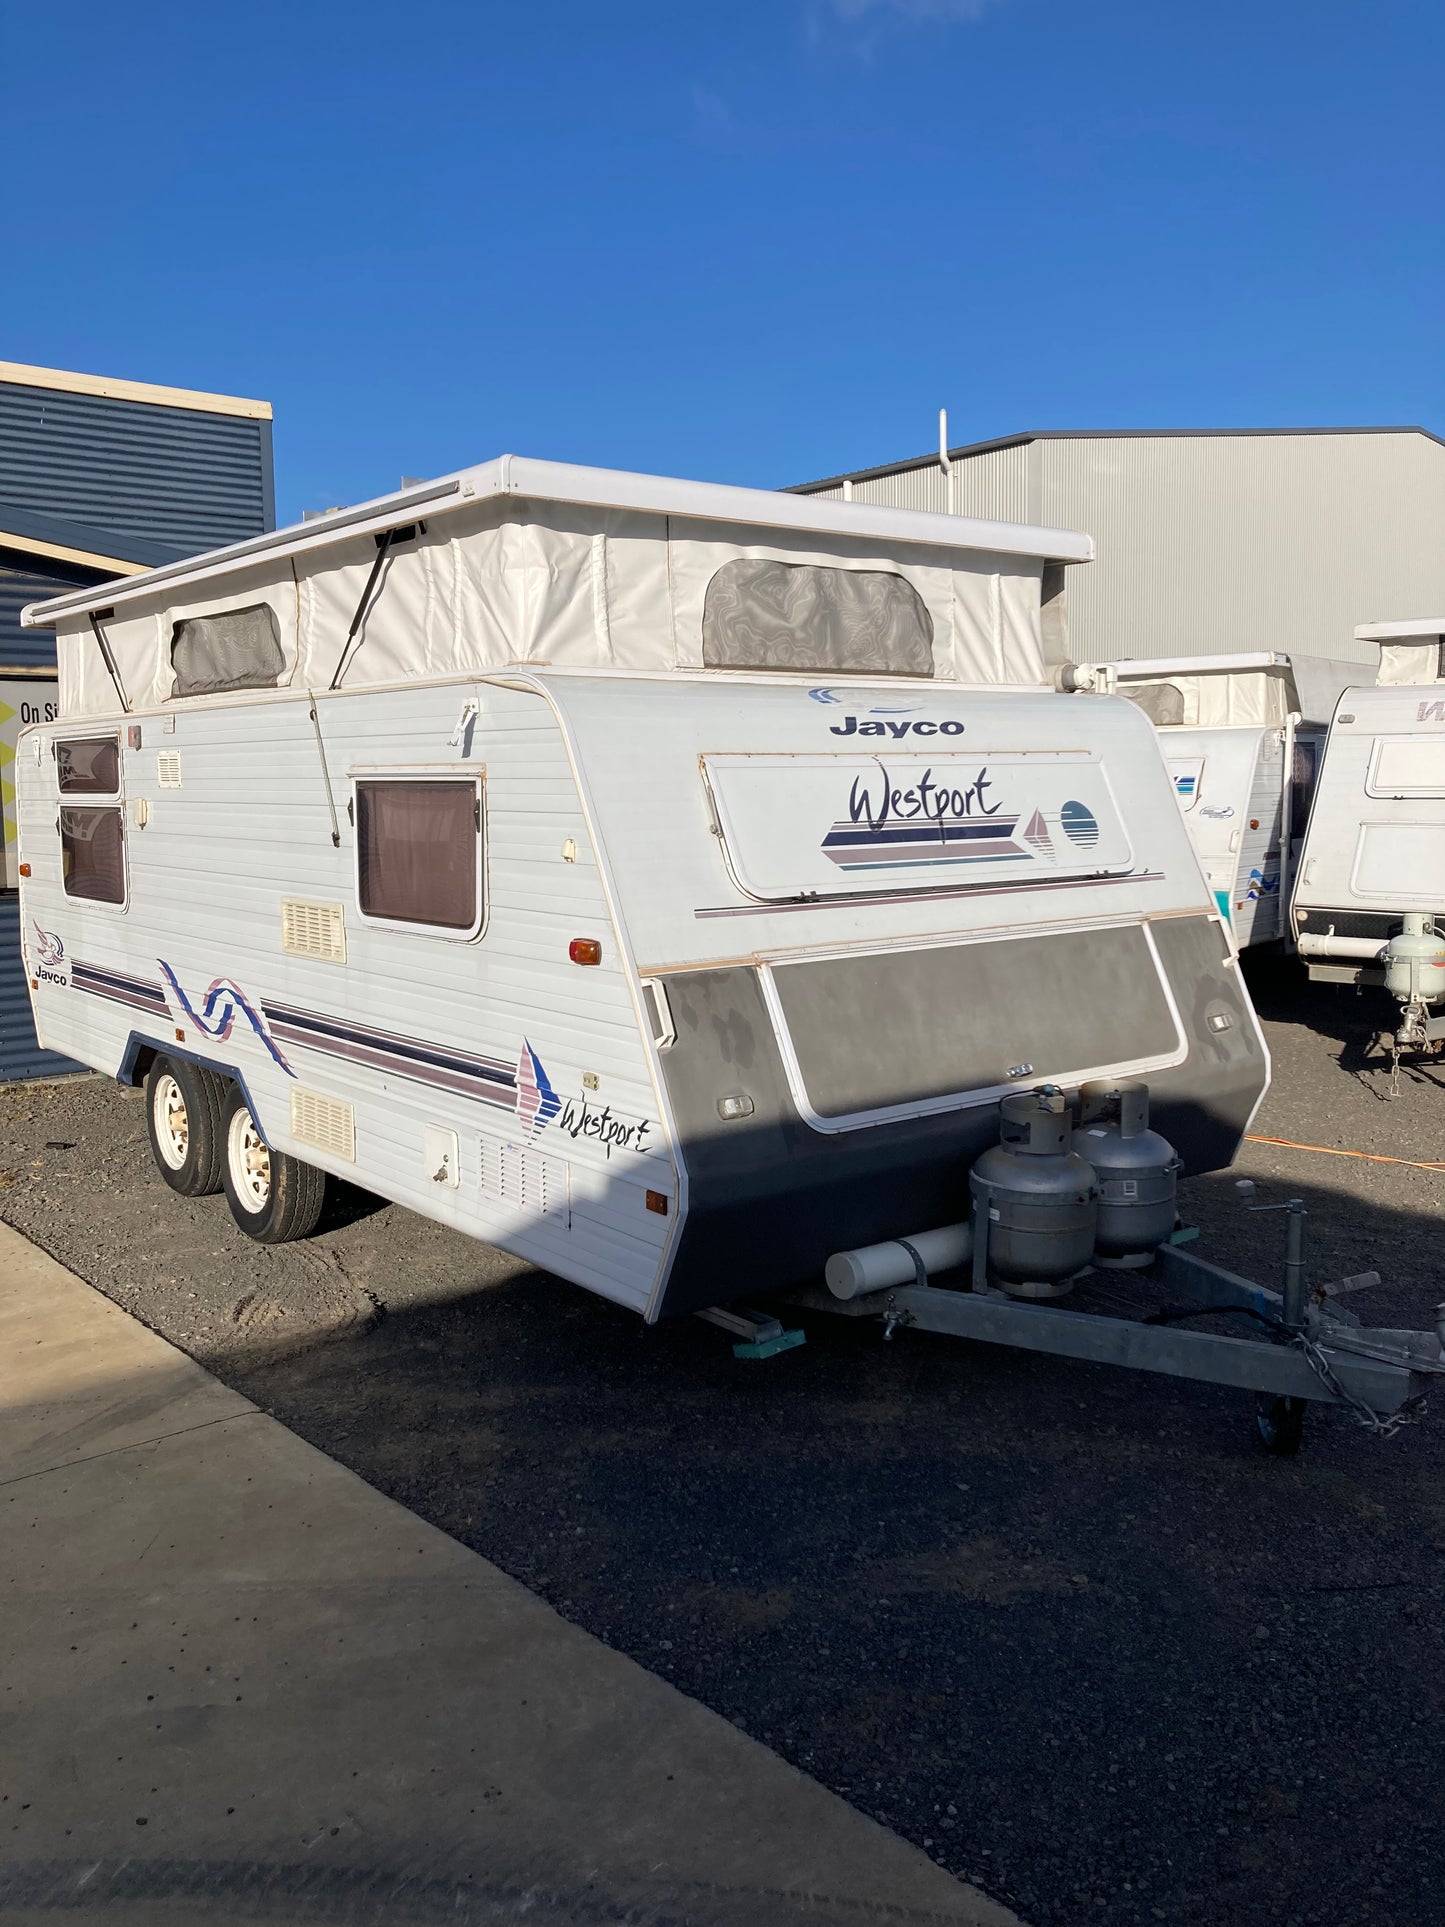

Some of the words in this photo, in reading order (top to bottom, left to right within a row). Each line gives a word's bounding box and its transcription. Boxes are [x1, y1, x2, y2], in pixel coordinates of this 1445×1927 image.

[20, 702, 40, 724] On
[829, 716, 965, 738] Jayco
[848, 757, 1004, 845] Westport
[35, 965, 67, 986] Jayco
[559, 1089, 653, 1160] Westport
